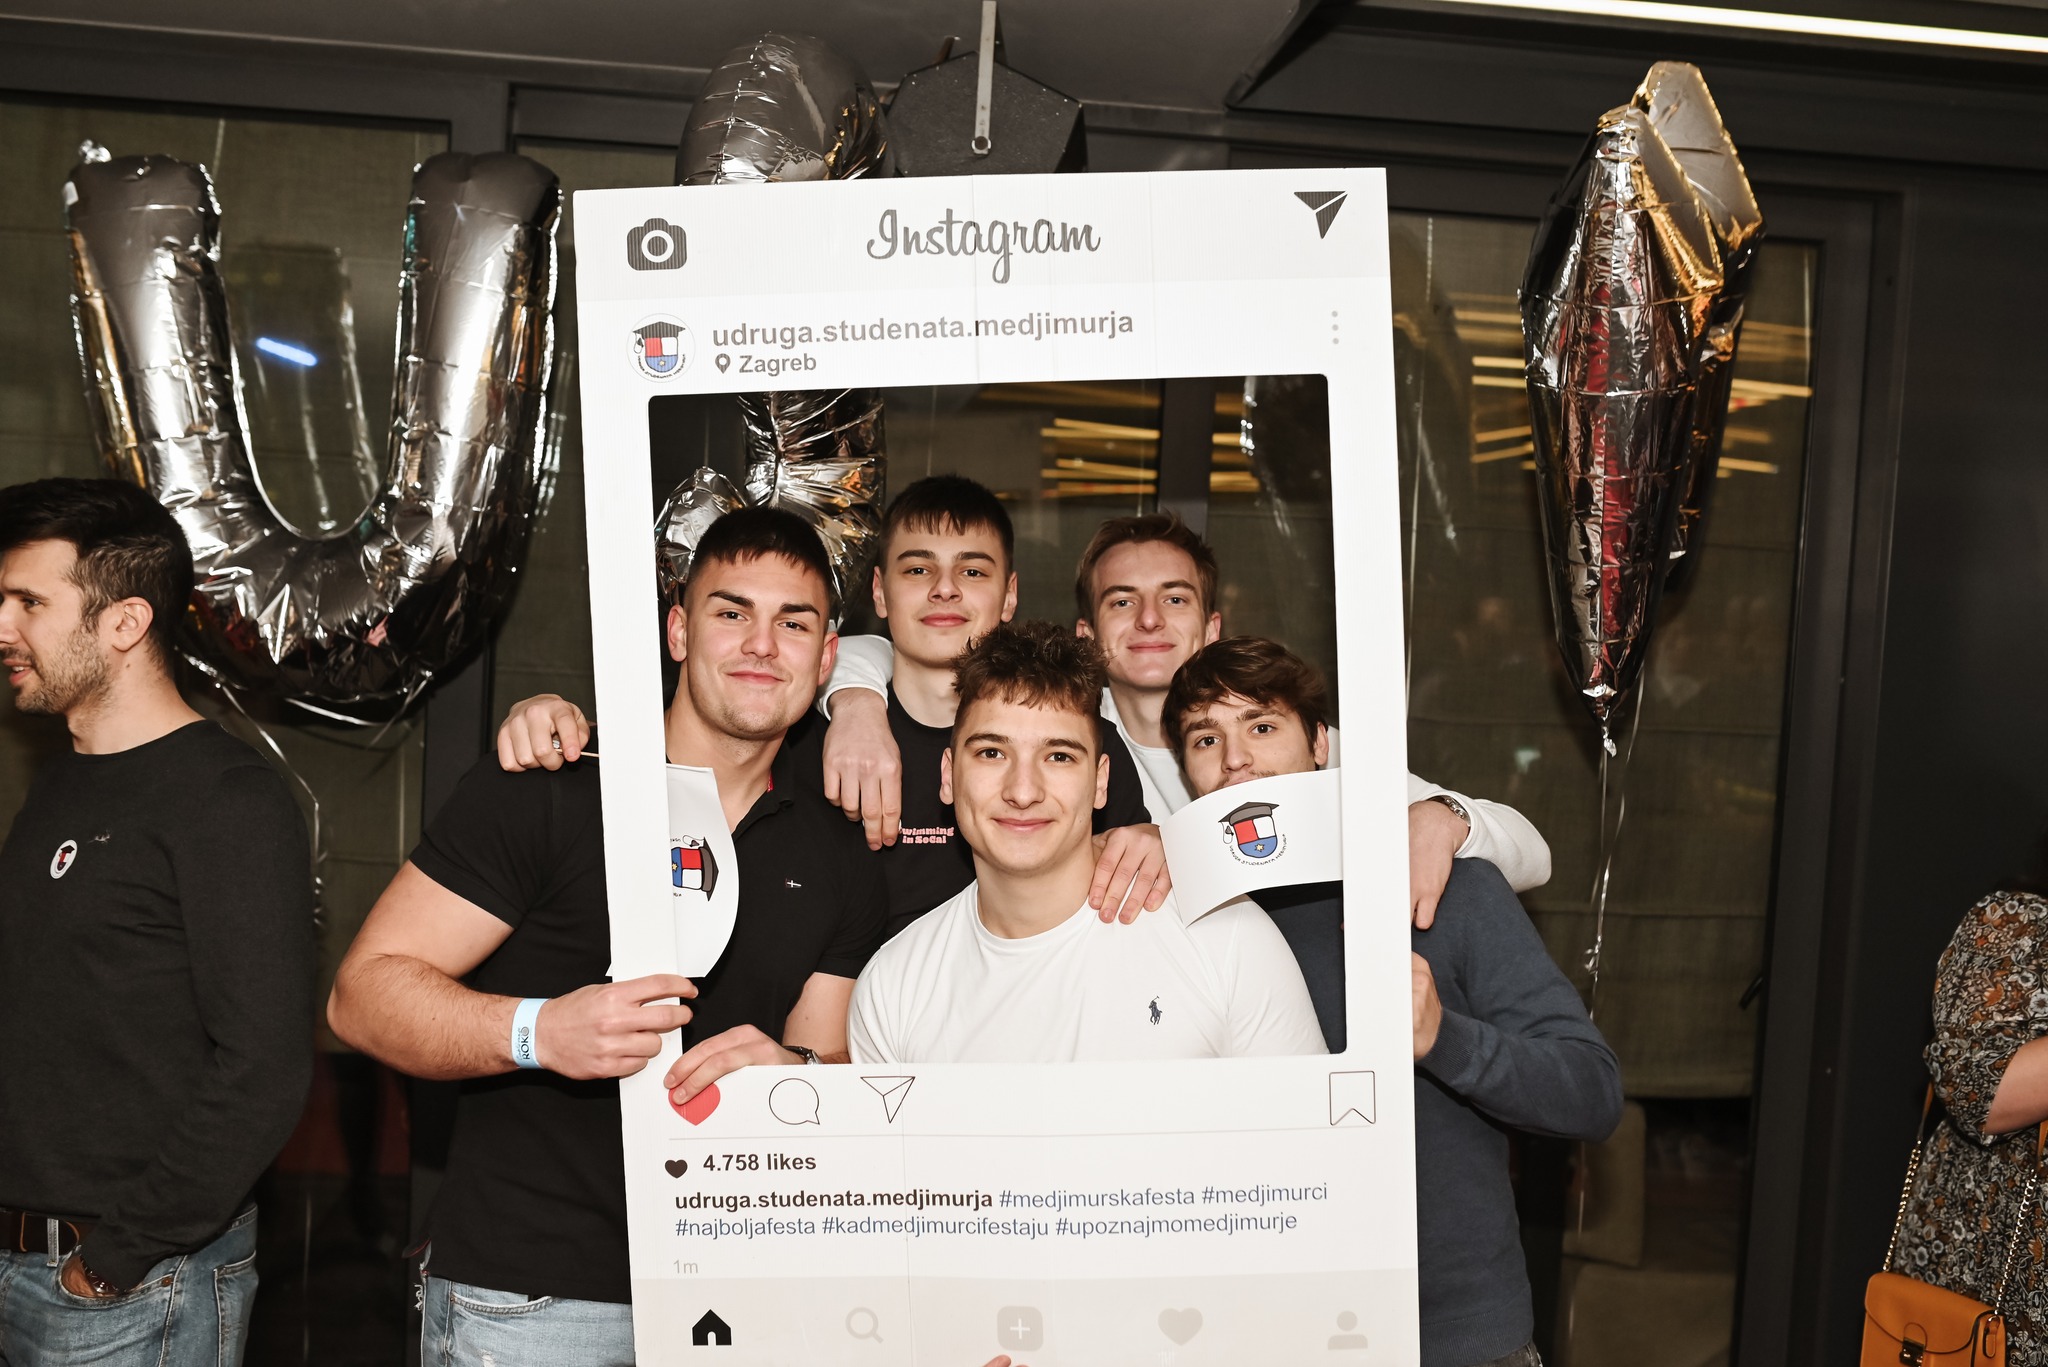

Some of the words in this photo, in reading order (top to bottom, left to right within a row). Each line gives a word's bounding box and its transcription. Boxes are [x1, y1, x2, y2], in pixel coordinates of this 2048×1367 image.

[867, 208, 1101, 284] Instagram
[713, 311, 1133, 350] udruga.studenata.medjimurja
[739, 353, 816, 376] Zagreb
[899, 827, 954, 836] wimming
[902, 836, 914, 844] in
[703, 1153, 760, 1171] 4.758
[767, 1153, 817, 1171] likes
[676, 1189, 993, 1212] udruga.studenata.medjimurja
[999, 1188, 1195, 1212] #medjimurskafesta
[1201, 1182, 1327, 1206] #medjimurci
[676, 1218, 815, 1240] #najboljafesta
[822, 1216, 1049, 1240] #kadmedjimurcifestaju
[1056, 1211, 1298, 1239] #upoznajmomedjimurje
[674, 1260, 698, 1274] 1m
